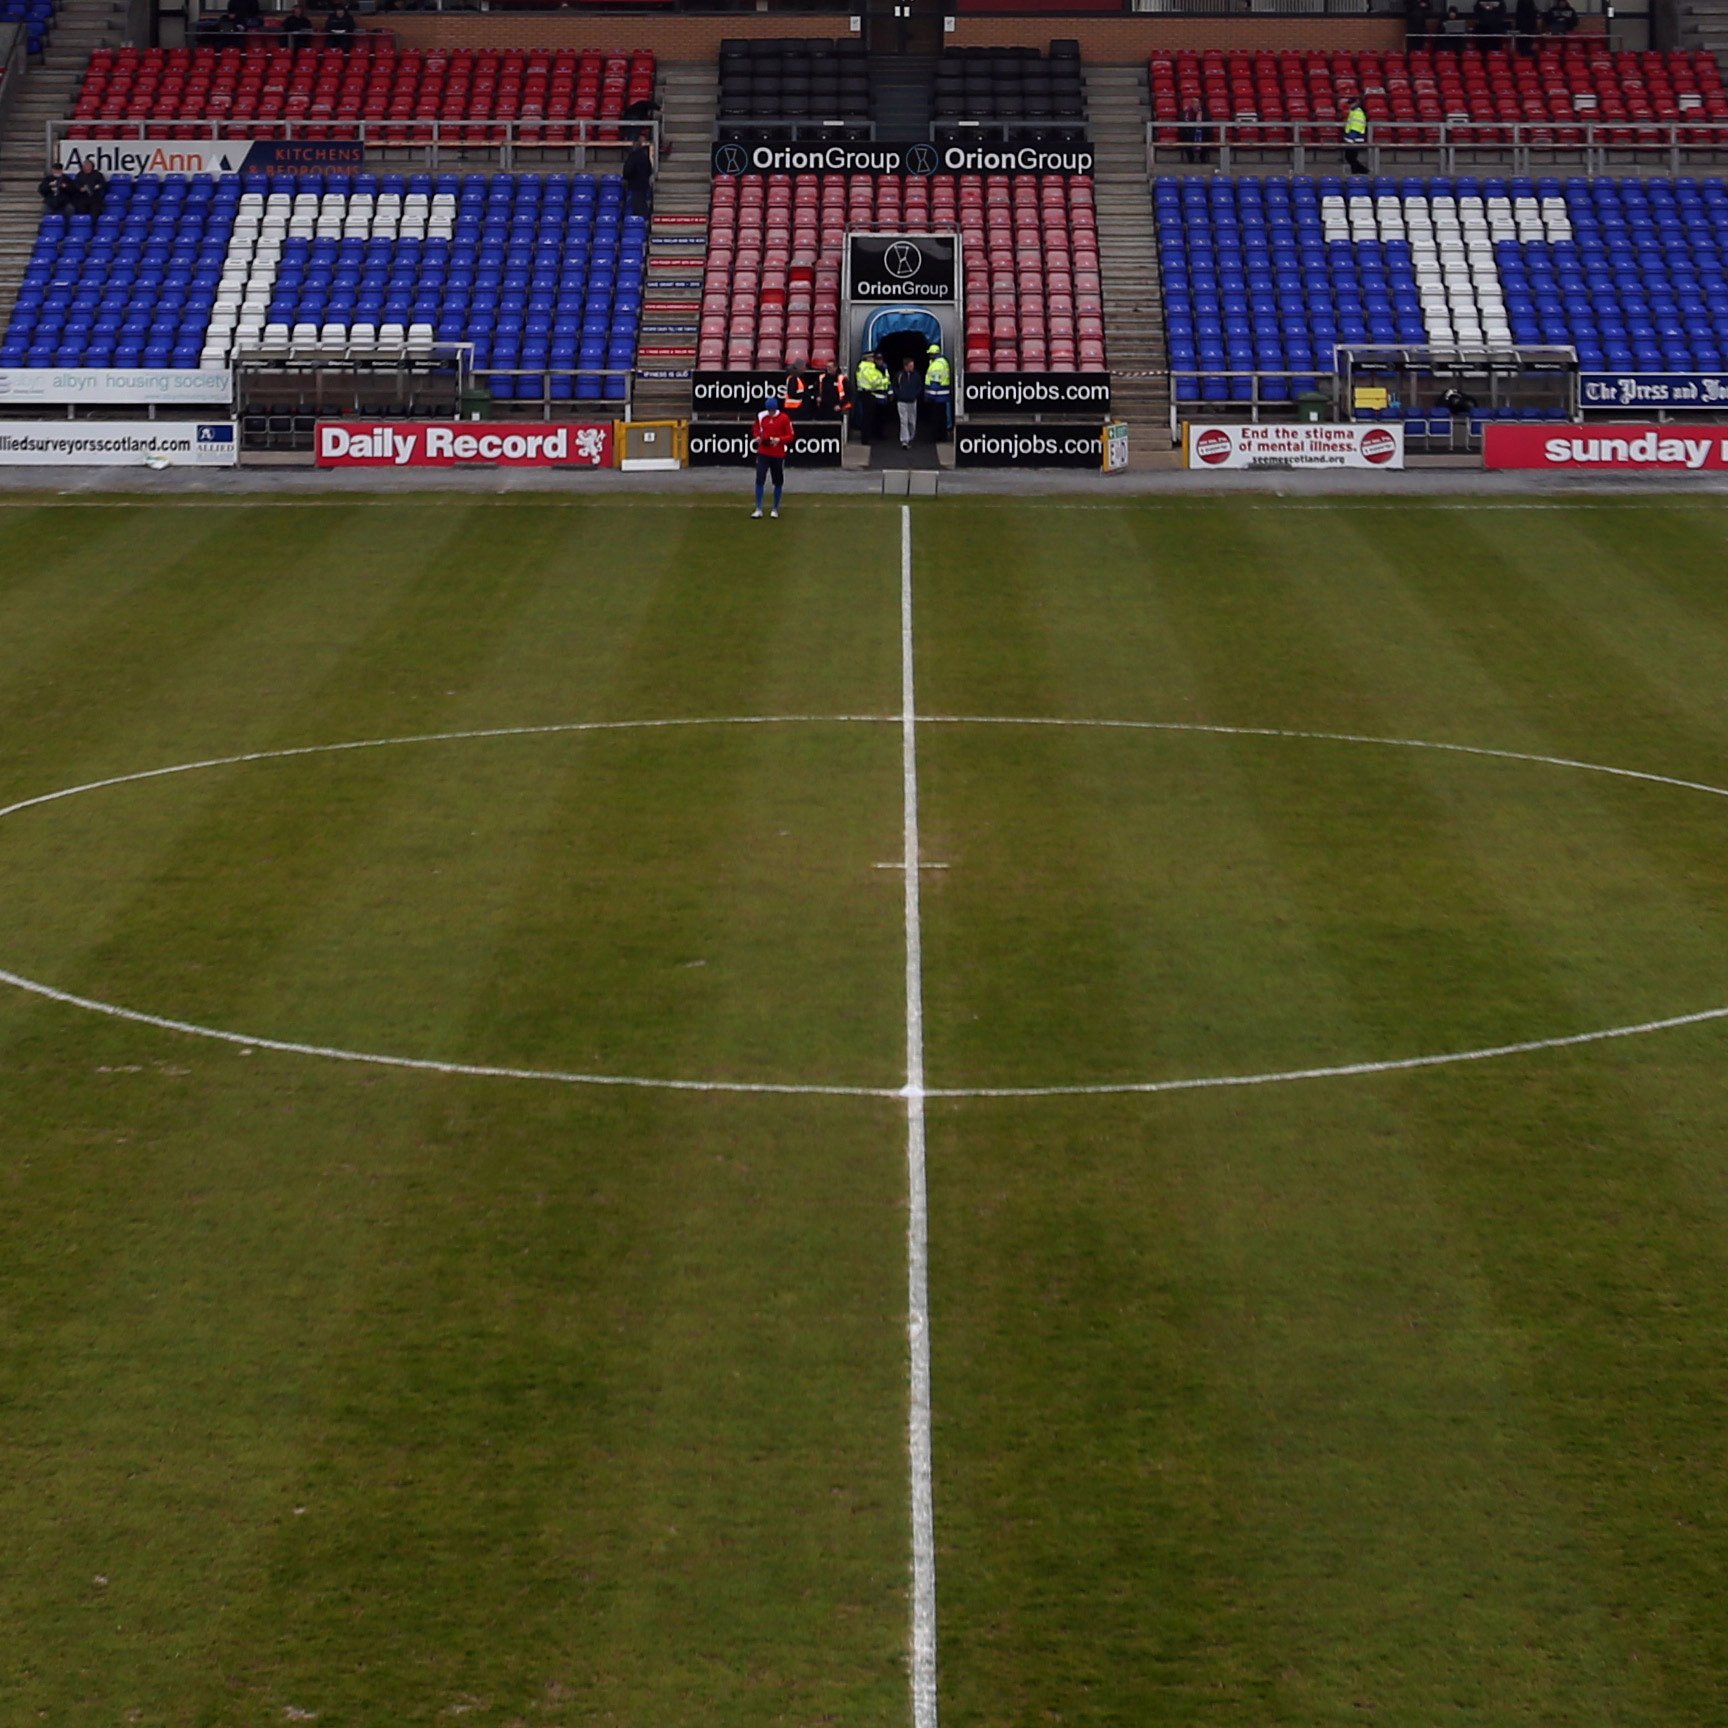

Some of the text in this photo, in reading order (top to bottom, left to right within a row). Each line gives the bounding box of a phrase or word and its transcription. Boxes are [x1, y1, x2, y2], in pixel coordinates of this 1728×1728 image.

[275, 149, 360, 160] KITCHENS
[753, 147, 900, 173] OrionGroup
[944, 148, 1092, 174] OrionGroup
[858, 281, 948, 297] OrionGroup
[53, 376, 230, 390] albyn housing society
[966, 381, 1109, 404] orionjobs.com
[1585, 379, 1617, 403] The
[1618, 379, 1669, 403] Press
[1673, 379, 1699, 403] and
[1241, 428, 1354, 440] End the stigma
[197, 444, 234, 452] ALLIED
[322, 427, 568, 465] Daily Record
[690, 434, 840, 458] orionjo.com
[1239, 441, 1252, 451] of
[1258, 441, 1304, 451] mental
[1310, 441, 1357, 451] illness.
[1545, 432, 1712, 468] sunday
